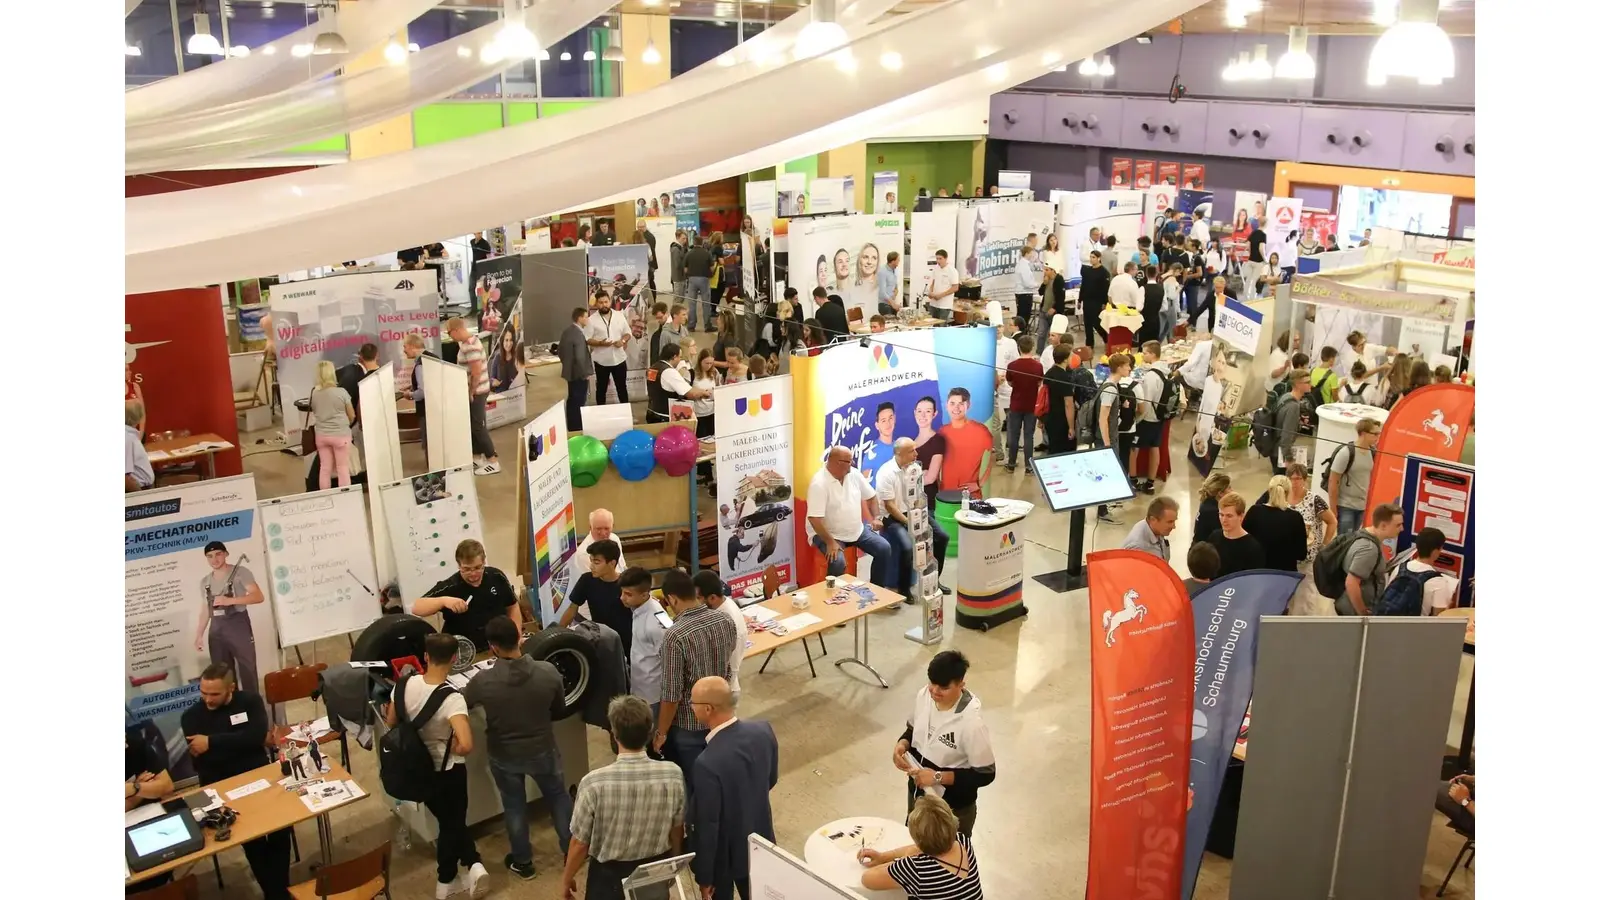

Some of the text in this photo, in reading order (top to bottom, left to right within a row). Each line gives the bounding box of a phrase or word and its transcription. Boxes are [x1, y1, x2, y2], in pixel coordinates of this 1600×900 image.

[980, 250, 1010, 270] Robin
[378, 311, 439, 324] Next Level
[277, 327, 304, 340] Wir
[422, 326, 439, 338] 5.0
[848, 371, 924, 391] MALERHANDWERK
[762, 432, 778, 440] UND
[831, 407, 865, 447] Deine
[722, 441, 789, 462] LACKIERERINNUNG
[734, 457, 777, 472] Schaumburg
[125, 502, 178, 519] smitautos
[125, 516, 240, 546] Z-MECHATRONIKER
[125, 533, 209, 556] PKW-TECHNIK (M/W)
[731, 580, 746, 591] DAS
[1202, 618, 1248, 708] Schaumburg
[142, 685, 201, 705] AUTOBERUFE.D
[938, 735, 957, 750] adidas
